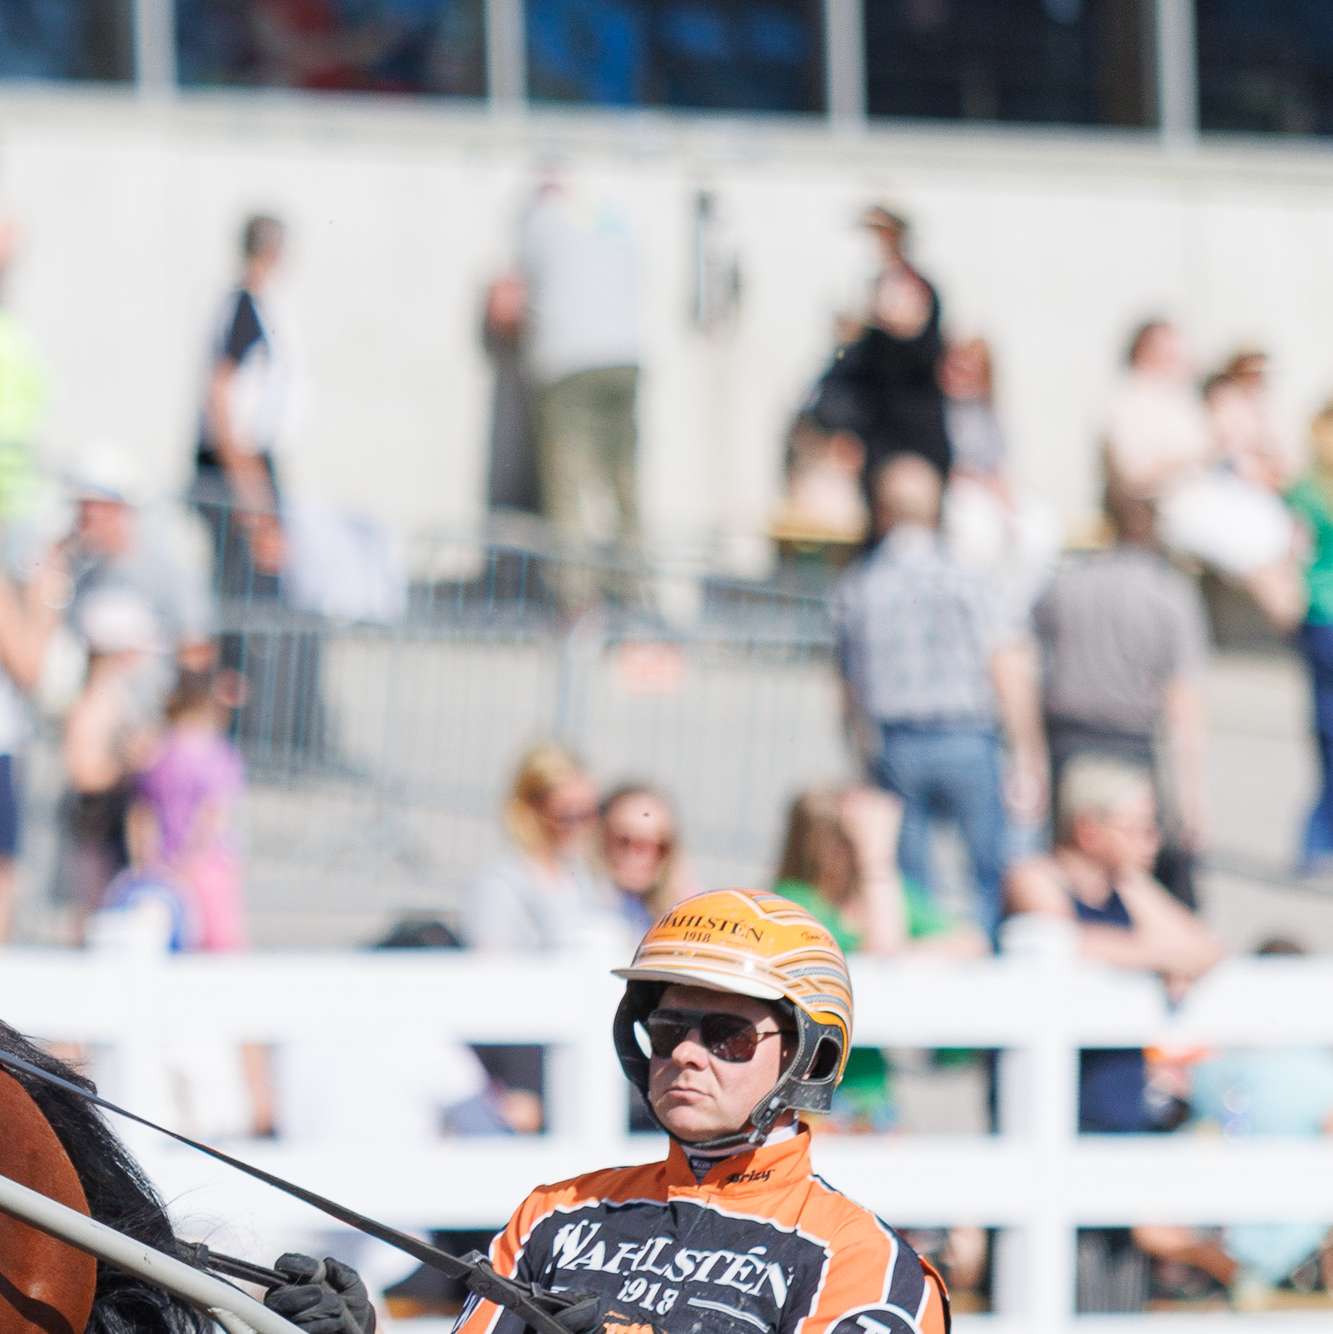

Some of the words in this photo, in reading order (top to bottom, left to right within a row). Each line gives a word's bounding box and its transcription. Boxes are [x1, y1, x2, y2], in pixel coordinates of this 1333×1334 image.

[683, 931, 711, 943] 1918
[545, 1218, 794, 1309] WAHLSTÉN
[617, 1277, 679, 1316] 1918
